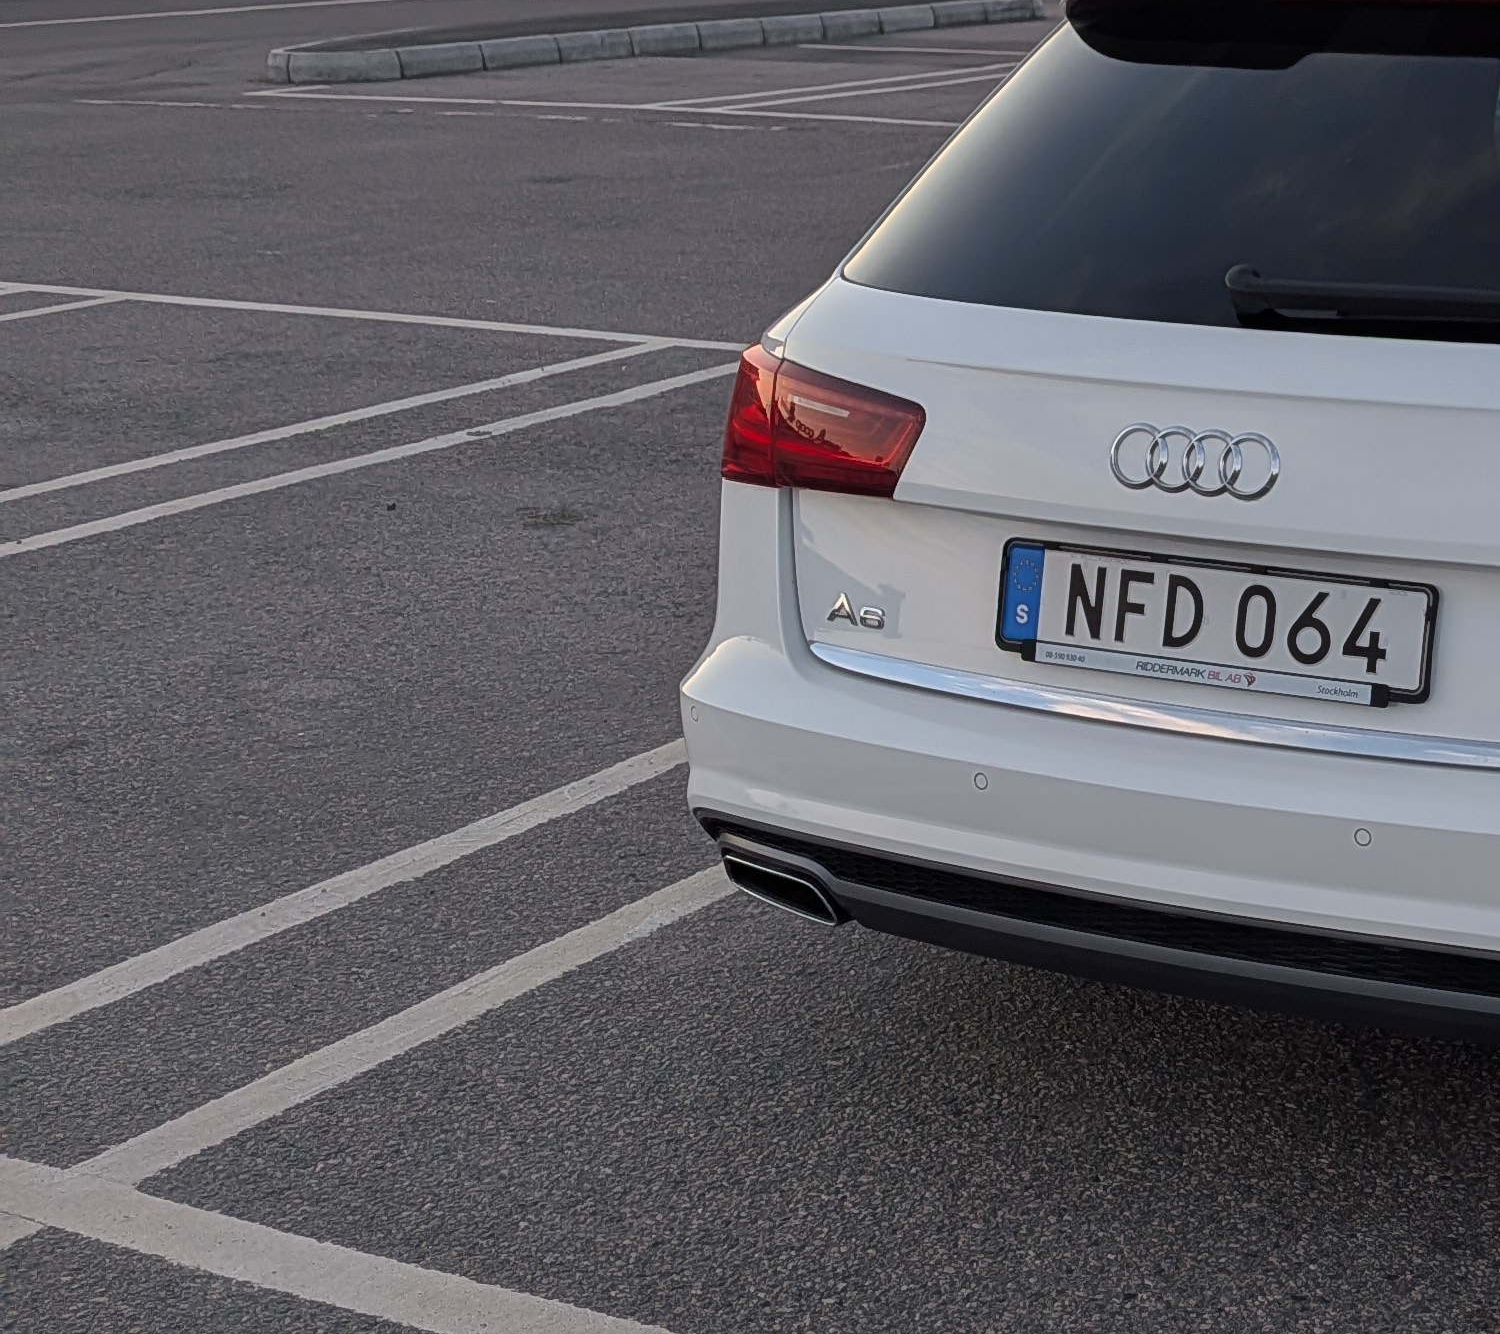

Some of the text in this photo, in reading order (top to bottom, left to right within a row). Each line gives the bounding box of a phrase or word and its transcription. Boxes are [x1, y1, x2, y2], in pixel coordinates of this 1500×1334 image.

[826, 591, 886, 630] A6
[1015, 603, 1030, 625] S
[1065, 562, 1387, 674] NFD 064
[1135, 660, 1242, 684] RIDDERMARK BIL AB
[1316, 684, 1359, 699] Stockholm
